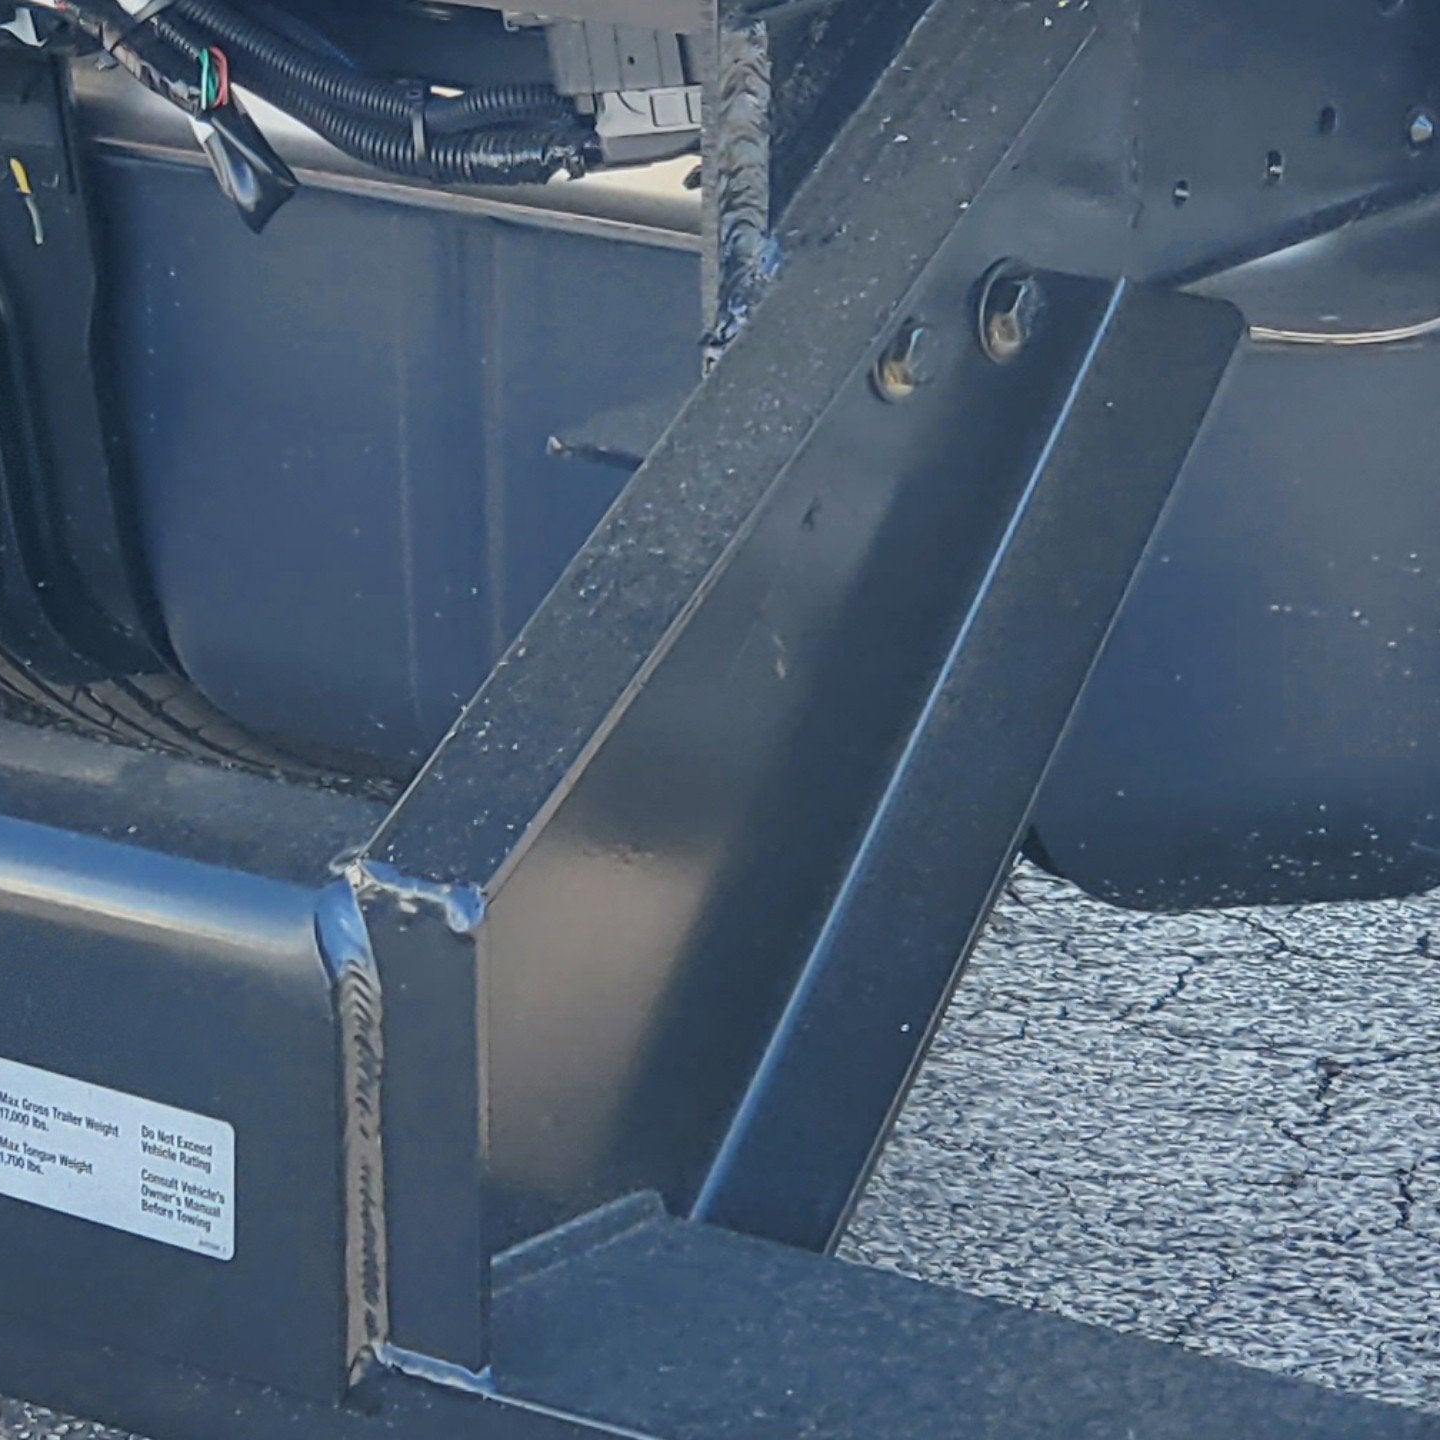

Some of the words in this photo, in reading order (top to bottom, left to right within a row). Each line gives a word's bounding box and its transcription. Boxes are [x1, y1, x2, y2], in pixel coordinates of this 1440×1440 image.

[22, 1098, 50, 1118] Gross
[52, 1106, 83, 1127] Trailer
[85, 1116, 119, 1138] Weight
[141, 1124, 155, 1140] Do
[157, 1129, 175, 1146] Not
[177, 1135, 213, 1157] Exceed
[22, 1142, 57, 1164] Tongue
[59, 1153, 94, 1175] Weight
[141, 1140, 177, 1162] Vehicle
[179, 1151, 212, 1175] Rating
[141, 1168, 179, 1191] Consult
[141, 1198, 174, 1220] Before
[176, 1209, 212, 1233] Towing
[184, 1196, 221, 1218] Manual
